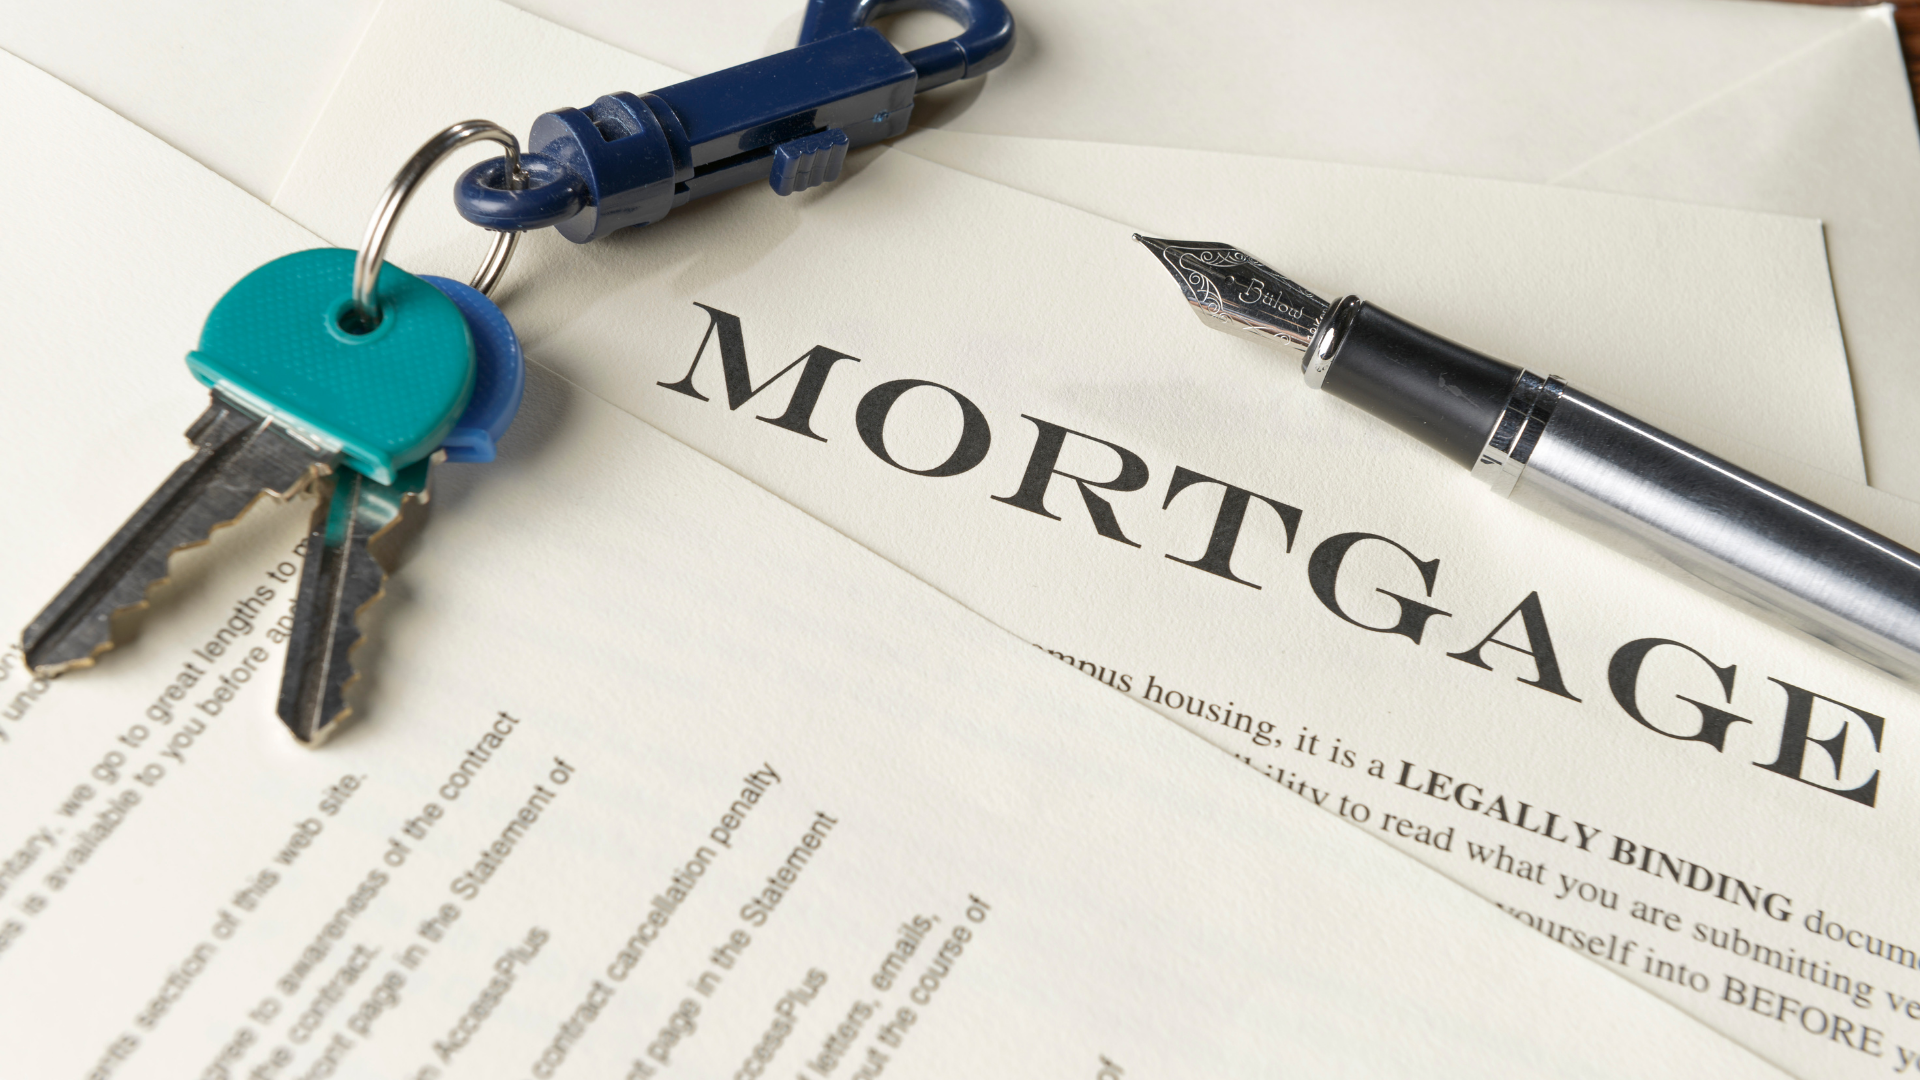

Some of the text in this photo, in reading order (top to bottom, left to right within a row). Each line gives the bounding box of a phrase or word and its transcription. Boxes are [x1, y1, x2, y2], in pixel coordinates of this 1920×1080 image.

[1239, 278, 1304, 319] Bülow
[656, 301, 1886, 808] MORTGAGE
[43, 789, 143, 892] available
[134, 763, 166, 787] to
[160, 713, 208, 765] you
[196, 644, 269, 717] before
[56, 783, 96, 817] we
[91, 750, 126, 785] go
[118, 724, 149, 748] to
[146, 661, 207, 725] great
[195, 581, 276, 664] lengths
[266, 562, 297, 584] to
[134, 940, 217, 1032] section
[211, 909, 241, 940] of
[232, 868, 281, 913] this
[274, 817, 324, 866] web
[318, 774, 367, 816] site.
[248, 996, 282, 1024] to
[276, 868, 390, 996] awareness
[383, 838, 412, 868] of
[401, 802, 445, 841] the
[438, 710, 521, 802] contract
[347, 971, 406, 1038] page
[392, 943, 430, 971] in
[417, 902, 462, 944] the
[450, 785, 556, 901] Statement
[549, 755, 577, 786] of
[531, 762, 782, 1080] contract cancellation penalty
[647, 998, 700, 1066] page
[688, 970, 722, 998] in
[709, 928, 752, 971] the
[739, 810, 839, 928] Statement
[1142, 675, 1282, 748] housing,
[1294, 726, 1320, 756] it
[1327, 738, 1357, 768] is
[1367, 759, 1386, 779] a
[1394, 760, 1602, 853] LEGALLY
[1609, 835, 1795, 923] BINDING
[1804, 910, 1920, 972] docum
[1339, 795, 1371, 824] to
[1380, 811, 1456, 852] read
[1466, 839, 1549, 885] what
[1554, 872, 1619, 911] you
[1629, 898, 1682, 932] are
[1691, 915, 1875, 1009] submitting
[432, 926, 551, 1065] AccessPlus
[805, 914, 942, 1078] letters, emails,
[877, 1005, 918, 1049] the
[909, 925, 973, 1006] course
[965, 893, 992, 924] of
[1644, 948, 1711, 994] into
[1722, 973, 1885, 1059] BEFORE
[1893, 1046, 1920, 1074] y
